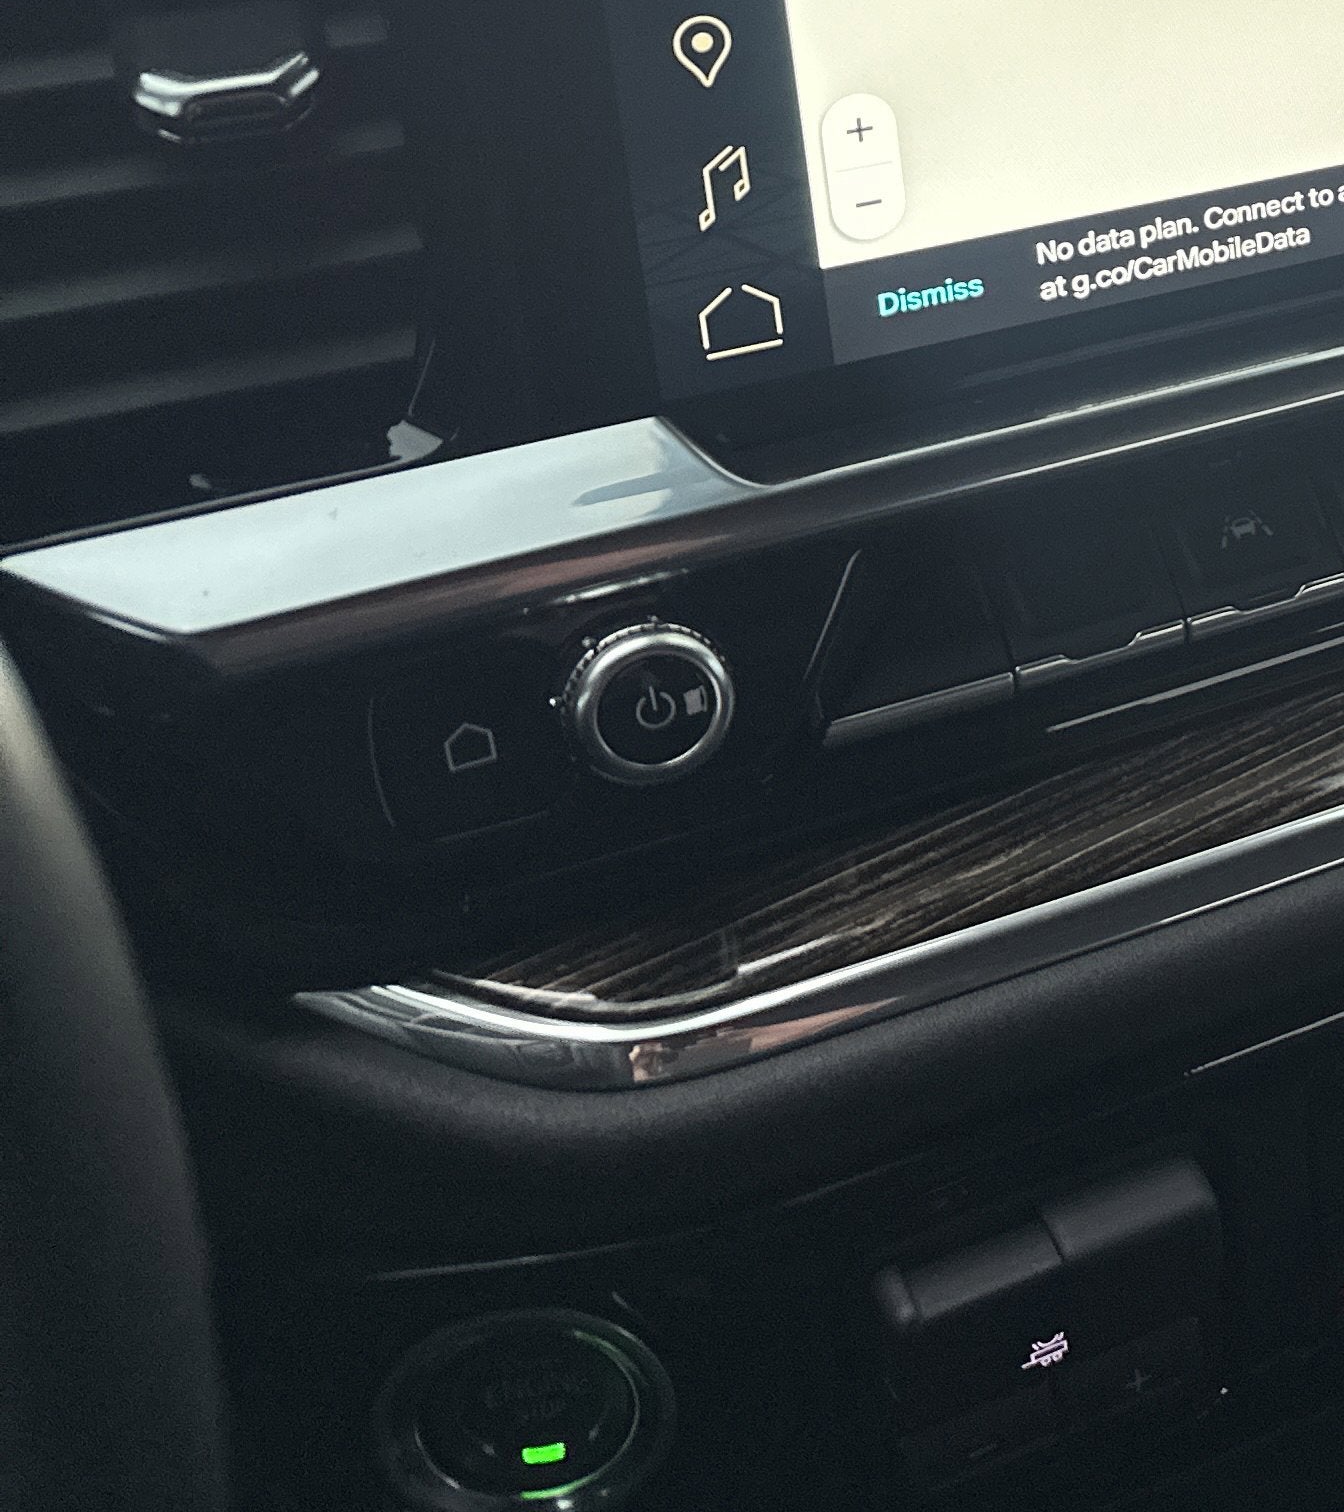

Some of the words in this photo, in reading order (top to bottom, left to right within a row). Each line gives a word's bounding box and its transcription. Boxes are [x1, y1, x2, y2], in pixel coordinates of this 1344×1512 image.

[1035, 239, 1074, 266] No
[1077, 228, 1135, 257] data
[1139, 216, 1199, 250] plan.
[1203, 191, 1305, 230] Connect
[1308, 186, 1334, 208] to
[1039, 273, 1069, 302] at
[1070, 224, 1312, 300] g.co/CarMobileData
[877, 277, 984, 317] Dismiss
